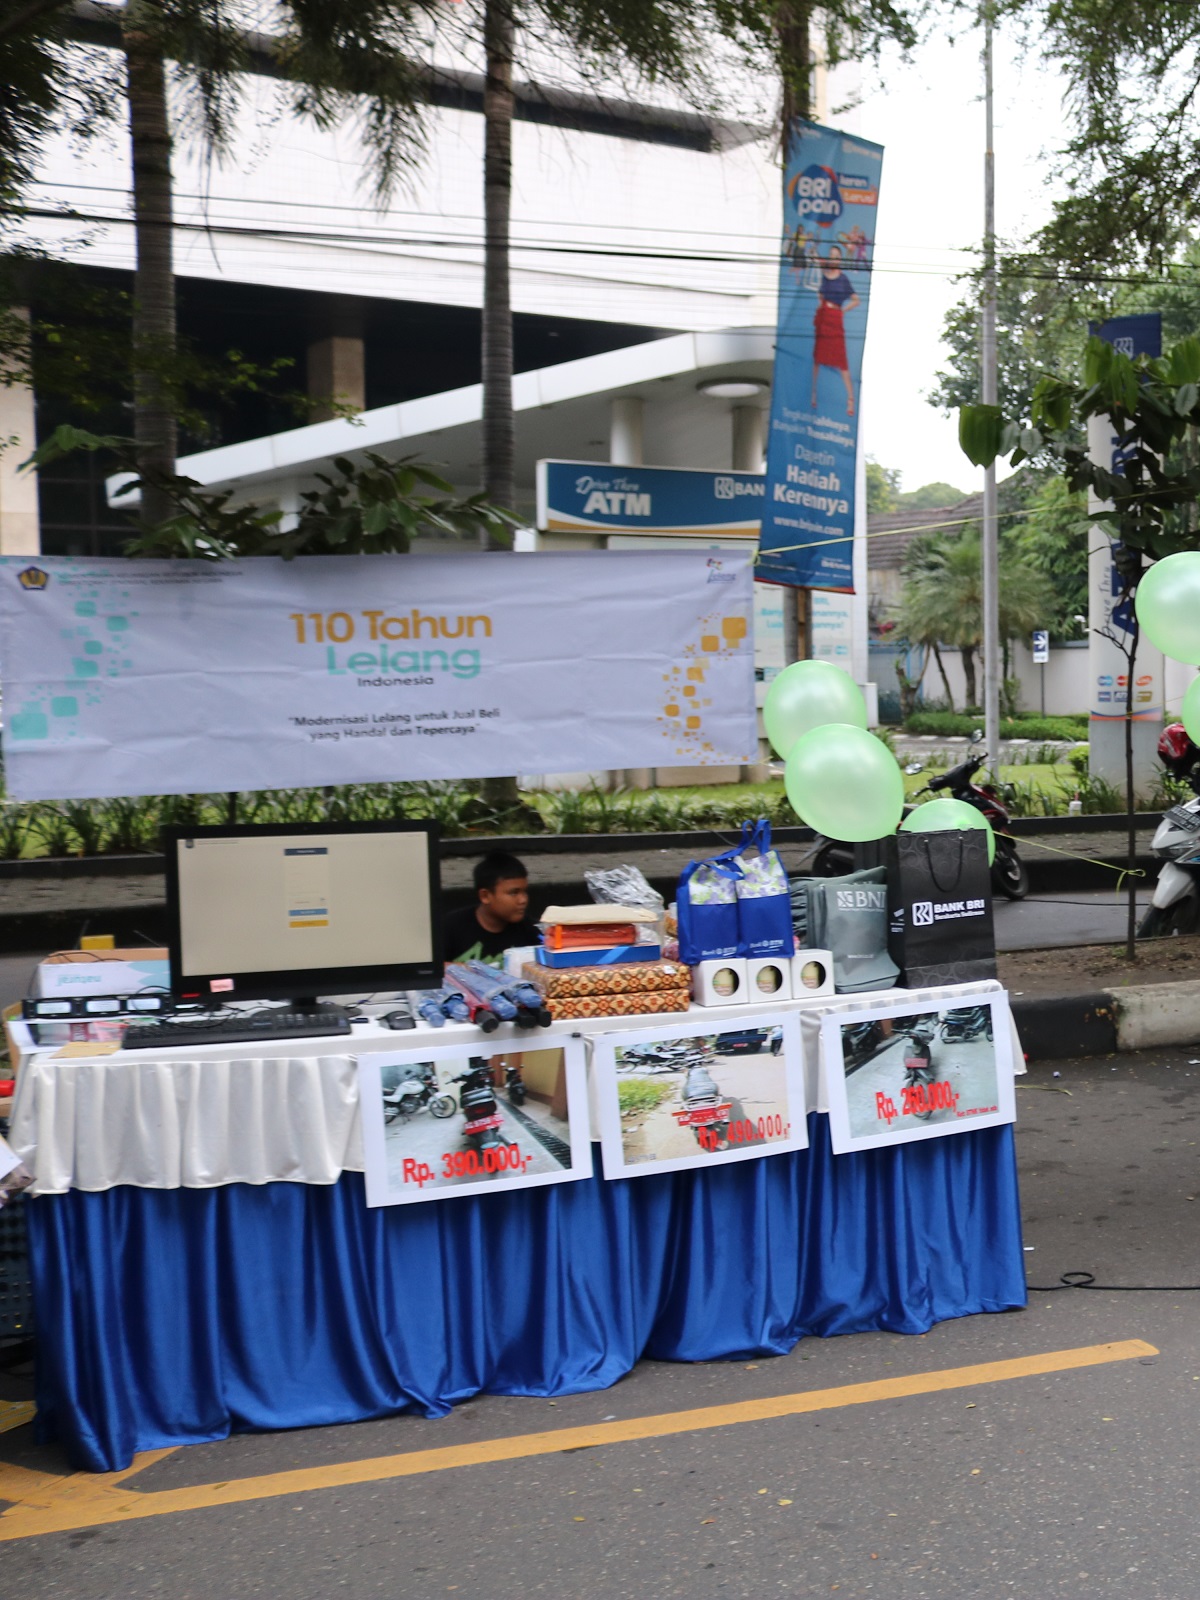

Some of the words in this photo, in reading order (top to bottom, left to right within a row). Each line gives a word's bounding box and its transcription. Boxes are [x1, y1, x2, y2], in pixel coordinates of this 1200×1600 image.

[798, 176, 832, 198] BRI
[798, 198, 840, 217] poin
[786, 464, 841, 492] Hadiah
[735, 483, 766, 497] BAN
[583, 491, 651, 517] ATM
[289, 611, 355, 644] 110
[361, 609, 493, 641] Tahun
[326, 643, 482, 680] Lelang
[357, 675, 435, 687] Indonesia
[373, 712, 411, 725] Lelang
[414, 711, 448, 722] untuk
[452, 709, 476, 720] Jual
[479, 708, 501, 719] Beli
[309, 731, 340, 743] yang
[344, 728, 387, 738] Handal
[391, 727, 412, 737] dan
[856, 890, 886, 908] BNI
[934, 902, 965, 914] BANK
[966, 899, 985, 910] BRI
[875, 1091, 899, 1126] Rp.
[697, 1126, 724, 1153] Rp.
[726, 1113, 791, 1144] 490.000,-
[402, 1157, 436, 1189] Rp.
[441, 1144, 533, 1179] 390.000,-
